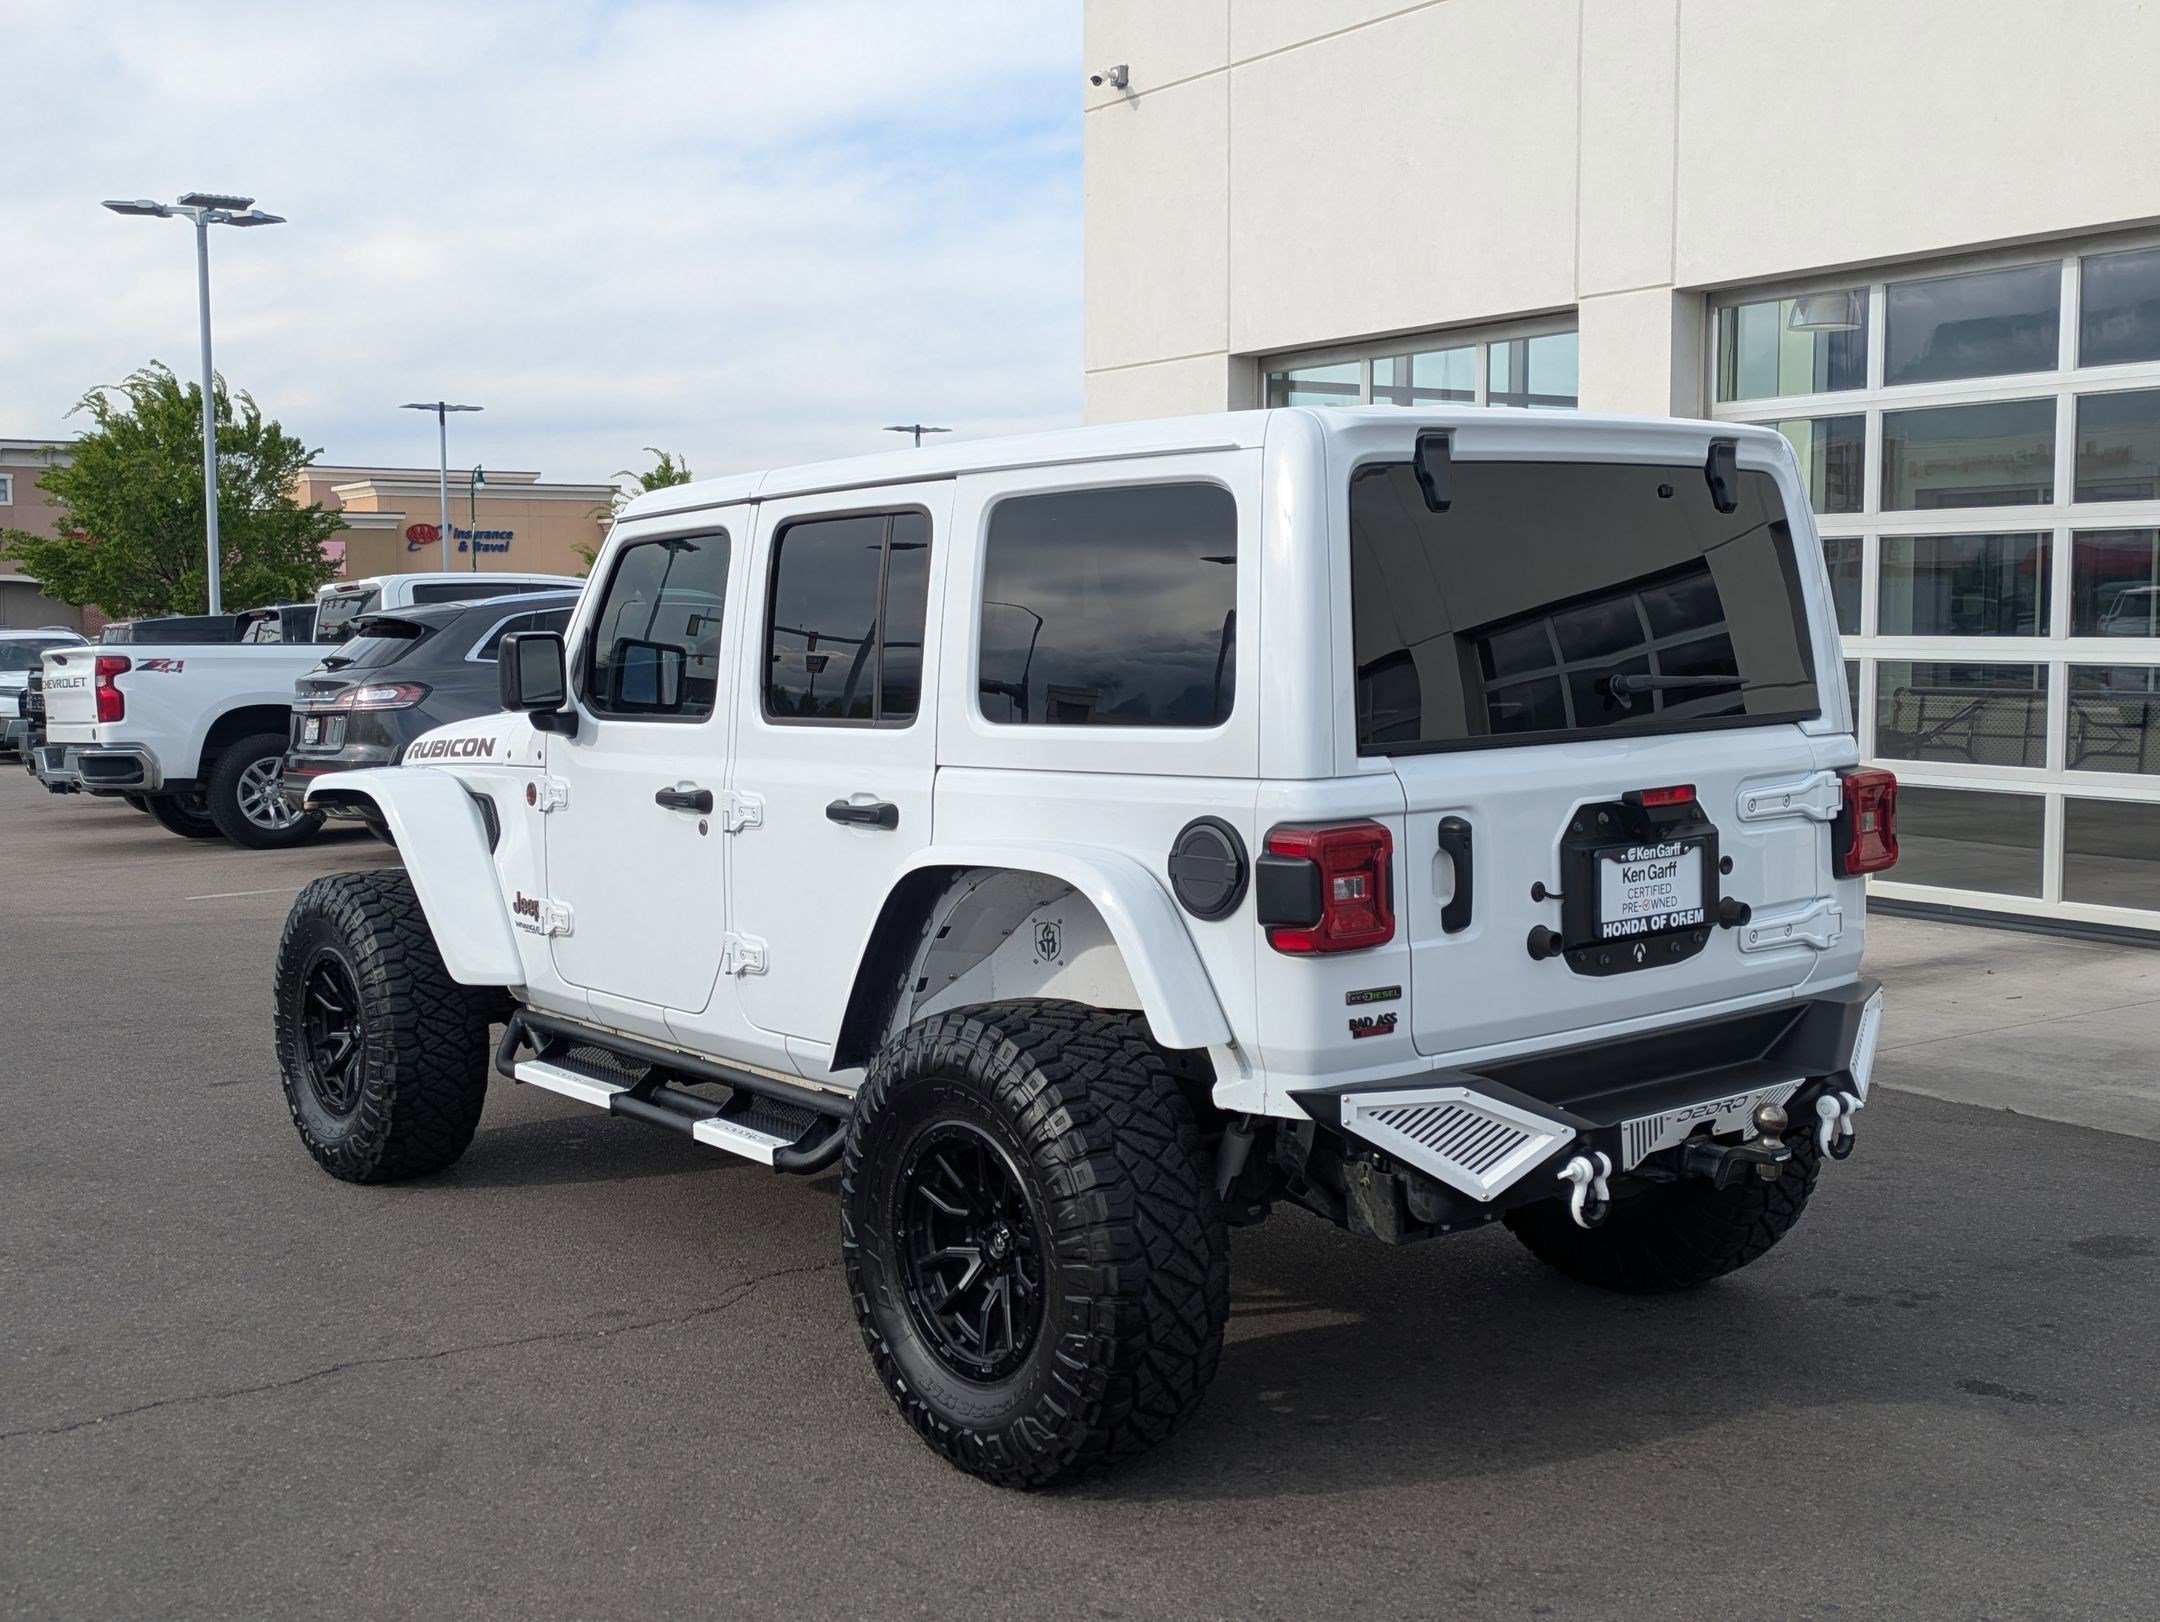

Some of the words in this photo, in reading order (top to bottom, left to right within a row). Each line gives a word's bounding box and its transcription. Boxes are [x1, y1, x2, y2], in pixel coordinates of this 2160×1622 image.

[453, 528, 514, 540] Insurance
[458, 541, 468, 552] &
[42, 677, 87, 690] CHEVROLET
[407, 738, 497, 760] RUBICON
[1636, 845, 1656, 860] Ken
[1656, 842, 1681, 858] Garff
[1622, 867, 1645, 884] Ken
[1647, 860, 1677, 880] Garff
[1627, 883, 1672, 900] CERTIFIED
[1603, 918, 1648, 938] HONDA
[1650, 914, 1668, 931] OF
[1669, 908, 1704, 927] OREM
[1349, 1016, 1374, 1031] BAD
[1376, 1012, 1398, 1025] ASS
